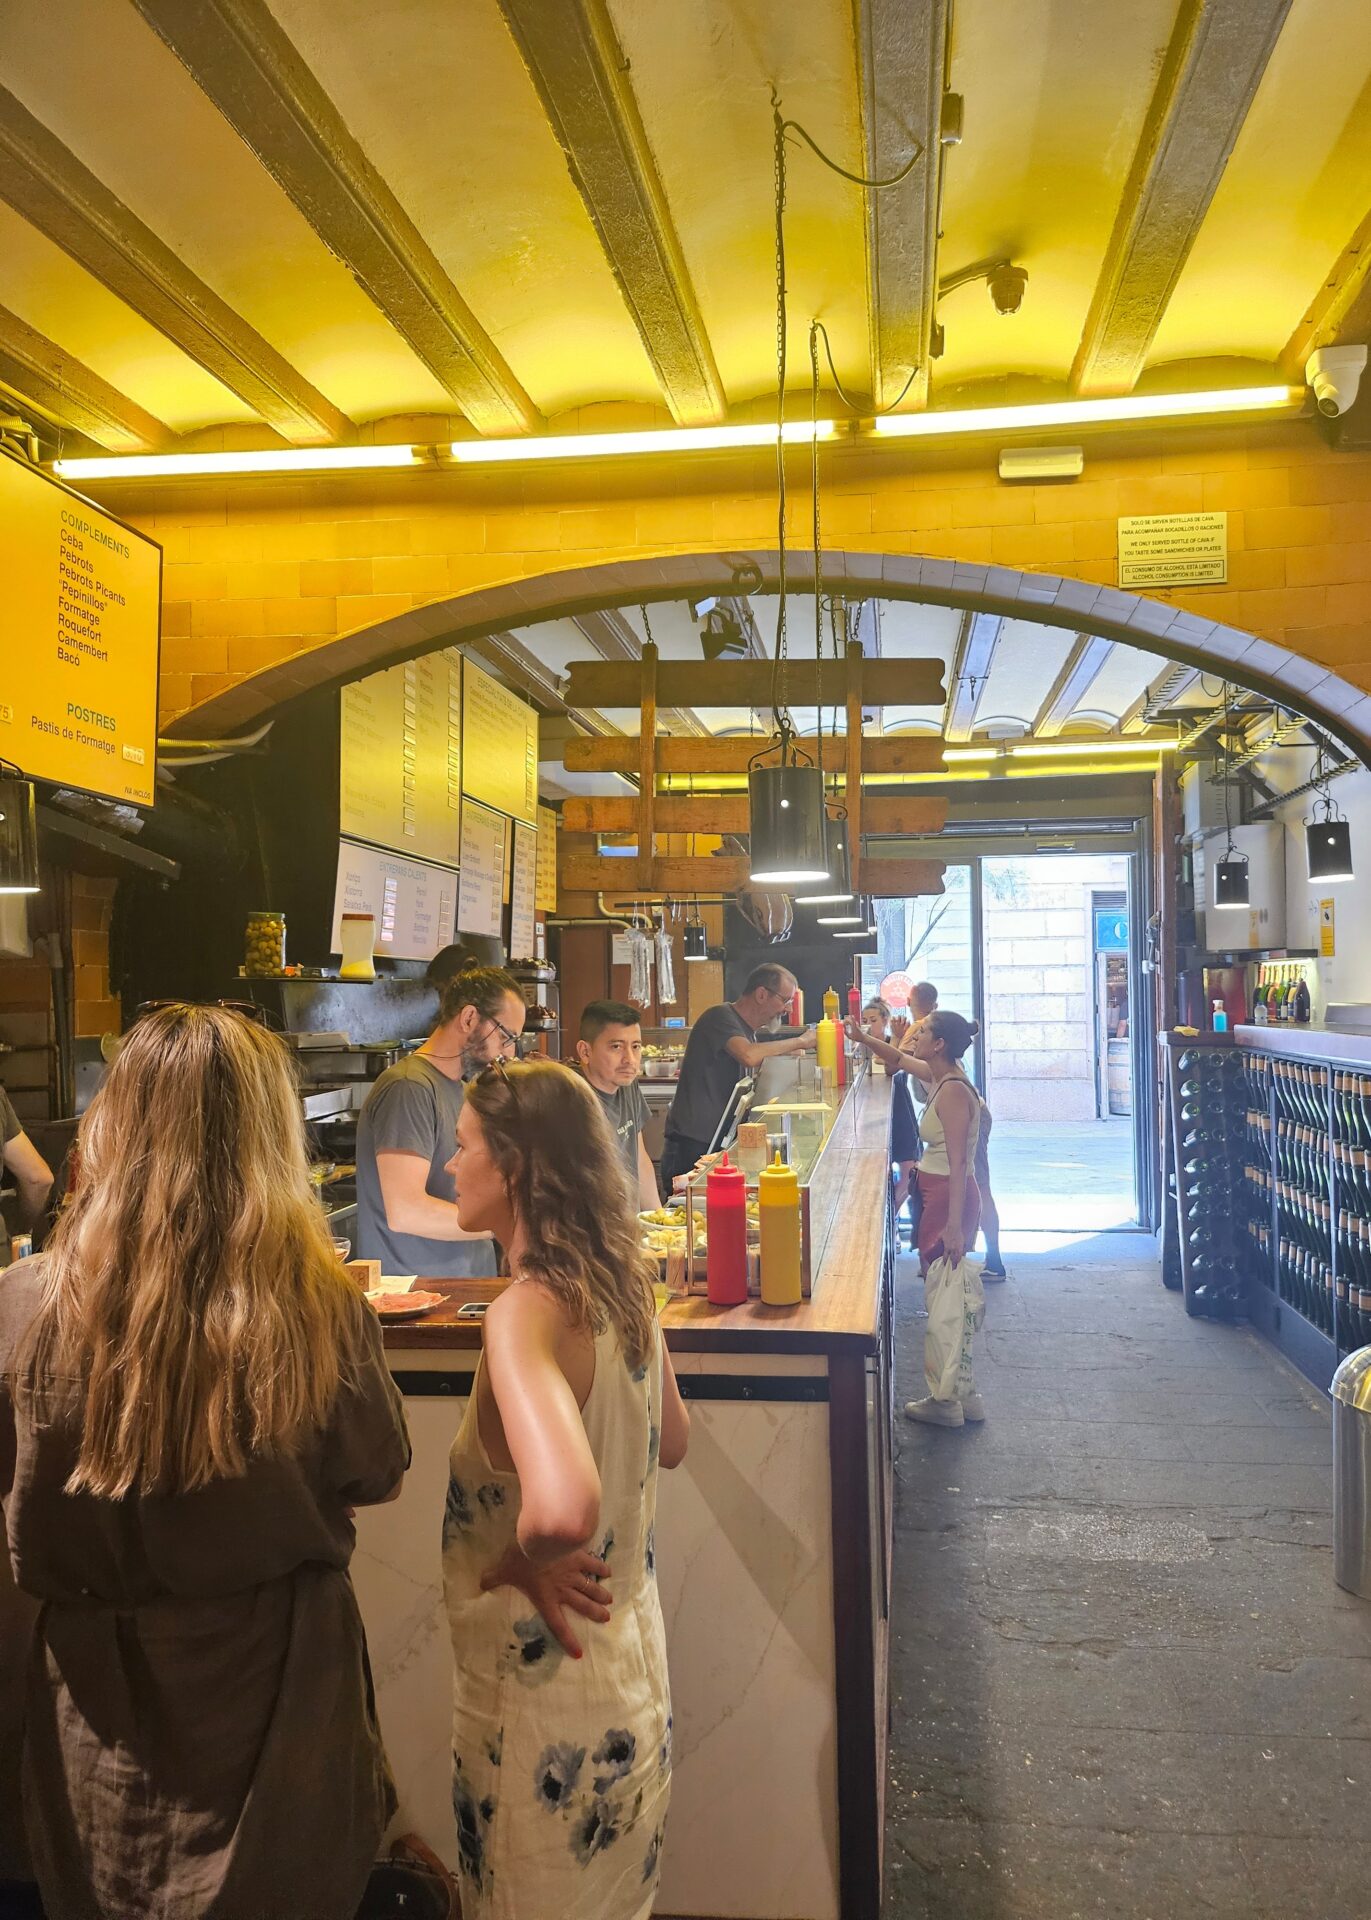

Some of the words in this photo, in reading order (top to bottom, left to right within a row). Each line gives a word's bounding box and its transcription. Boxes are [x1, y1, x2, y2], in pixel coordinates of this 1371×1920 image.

[60, 529, 84, 551] Ceba
[61, 510, 130, 559] COMPLEMENTS
[60, 545, 94, 573] Pebrots
[59, 562, 94, 590] Pebrots
[96, 581, 126, 607] Picants
[58, 595, 100, 626] Formatge
[58, 612, 102, 644] Roquefort
[57, 630, 108, 662] Camembert
[57, 646, 80, 667] Bacó
[66, 702, 117, 732] POSTRES
[31, 715, 60, 737] Pastis
[62, 726, 74, 740] de
[76, 730, 116, 755] Formatge
